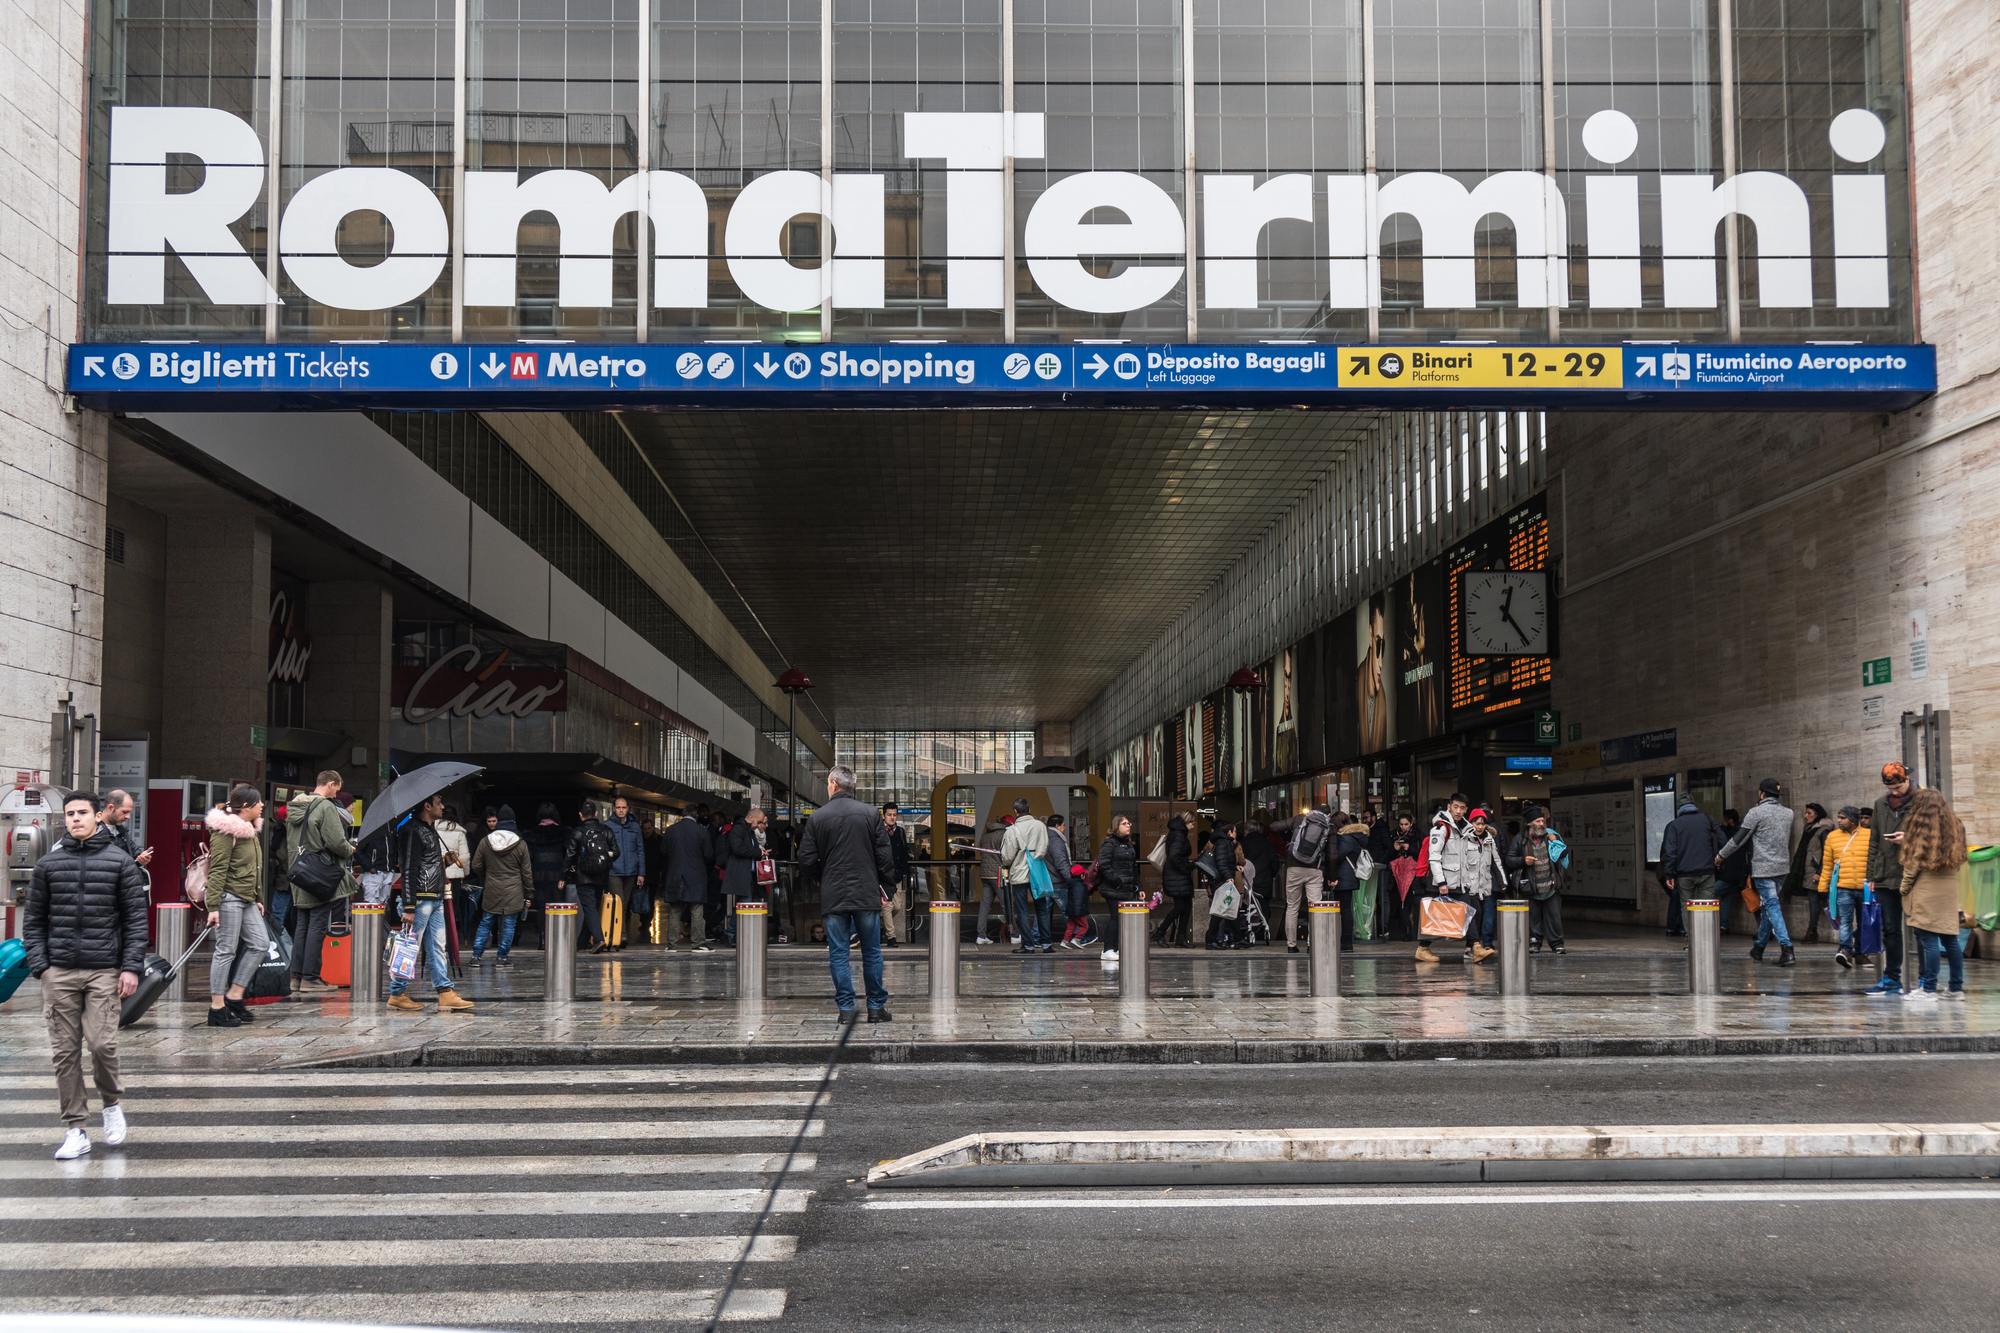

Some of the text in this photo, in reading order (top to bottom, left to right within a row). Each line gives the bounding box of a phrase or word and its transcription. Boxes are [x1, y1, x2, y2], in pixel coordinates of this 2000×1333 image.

[149, 352, 369, 384] Biglietti Tickets
[547, 353, 646, 378] Metro
[820, 352, 975, 384] Shopping
[1148, 352, 1325, 374] Deposito Bagagli
[1412, 352, 1473, 369] Binari
[1696, 353, 1907, 372] Fiumicino Aeroporto
[1148, 371, 1216, 385] Left Luggage
[1412, 370, 1460, 382] Platforms
[1696, 371, 1785, 385] Fiumicino Airport
[403, 643, 565, 724] Ciao
